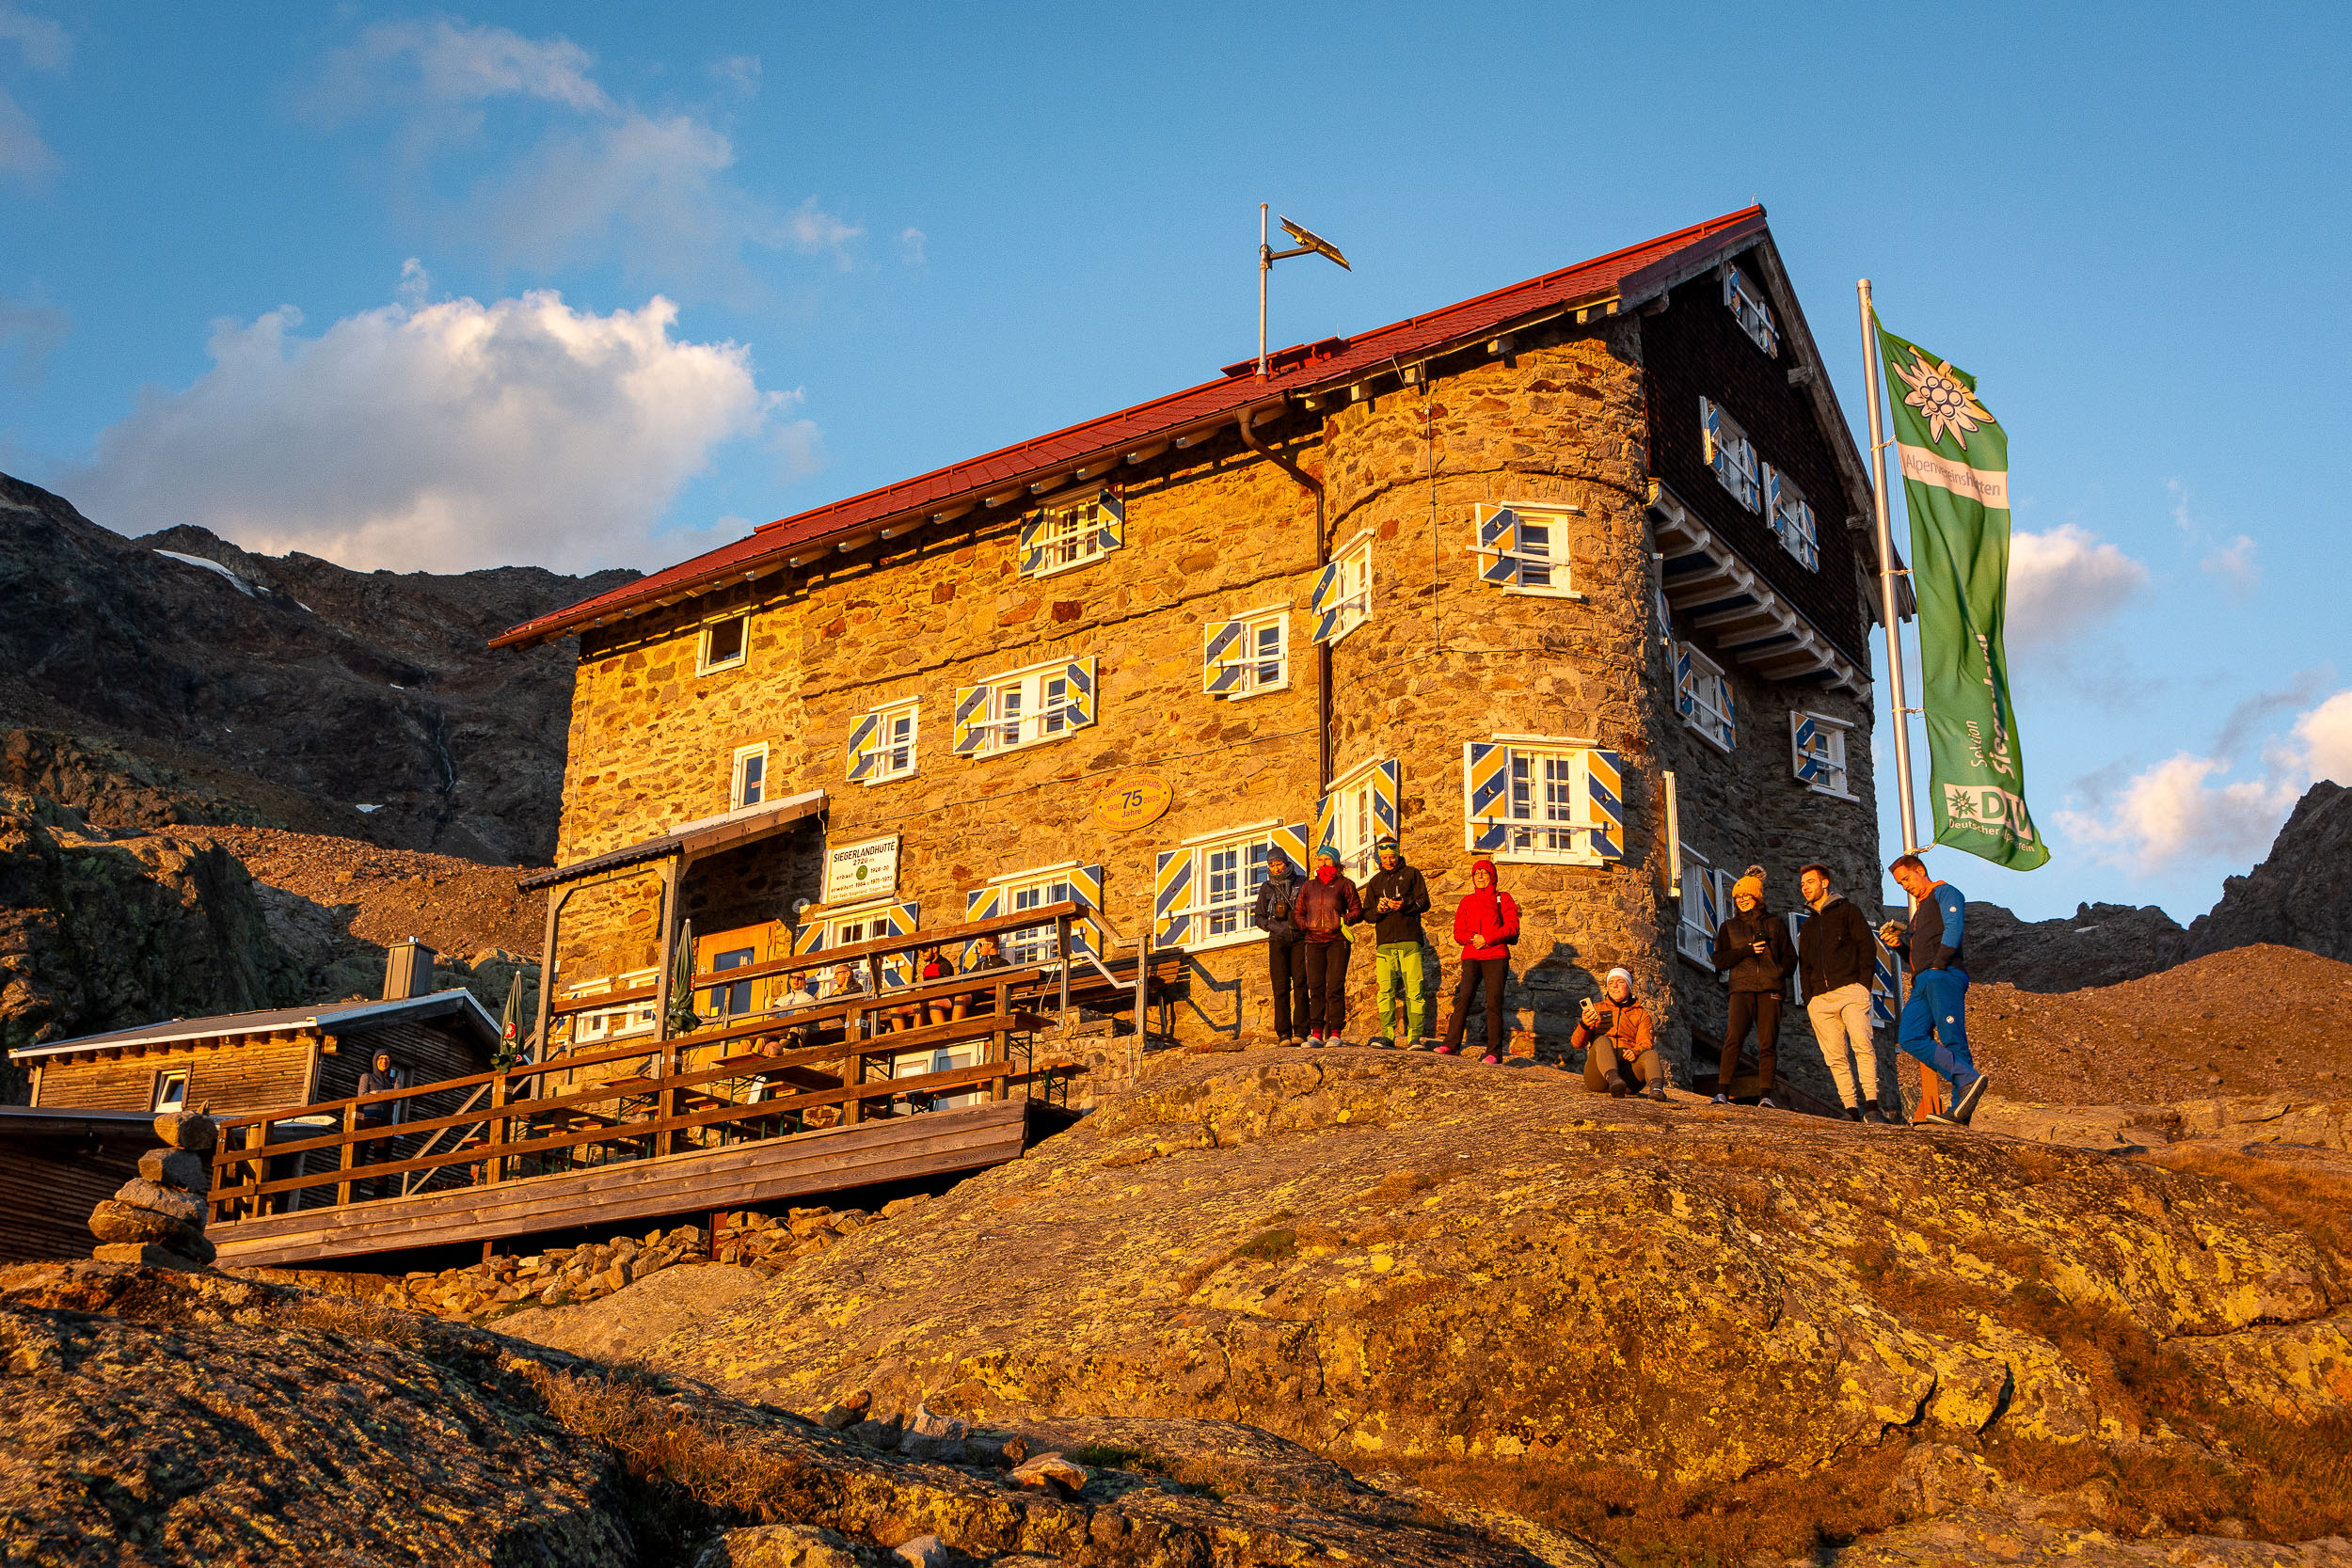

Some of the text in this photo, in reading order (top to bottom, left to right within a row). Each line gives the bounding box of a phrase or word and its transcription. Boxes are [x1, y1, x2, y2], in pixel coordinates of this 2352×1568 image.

[1905, 453, 2001, 496] Alpenvereinshtten
[1106, 789, 1161, 812] 1930 75 2005
[1121, 809, 1141, 818] Jahre
[1948, 818, 2000, 836] Deutscher
